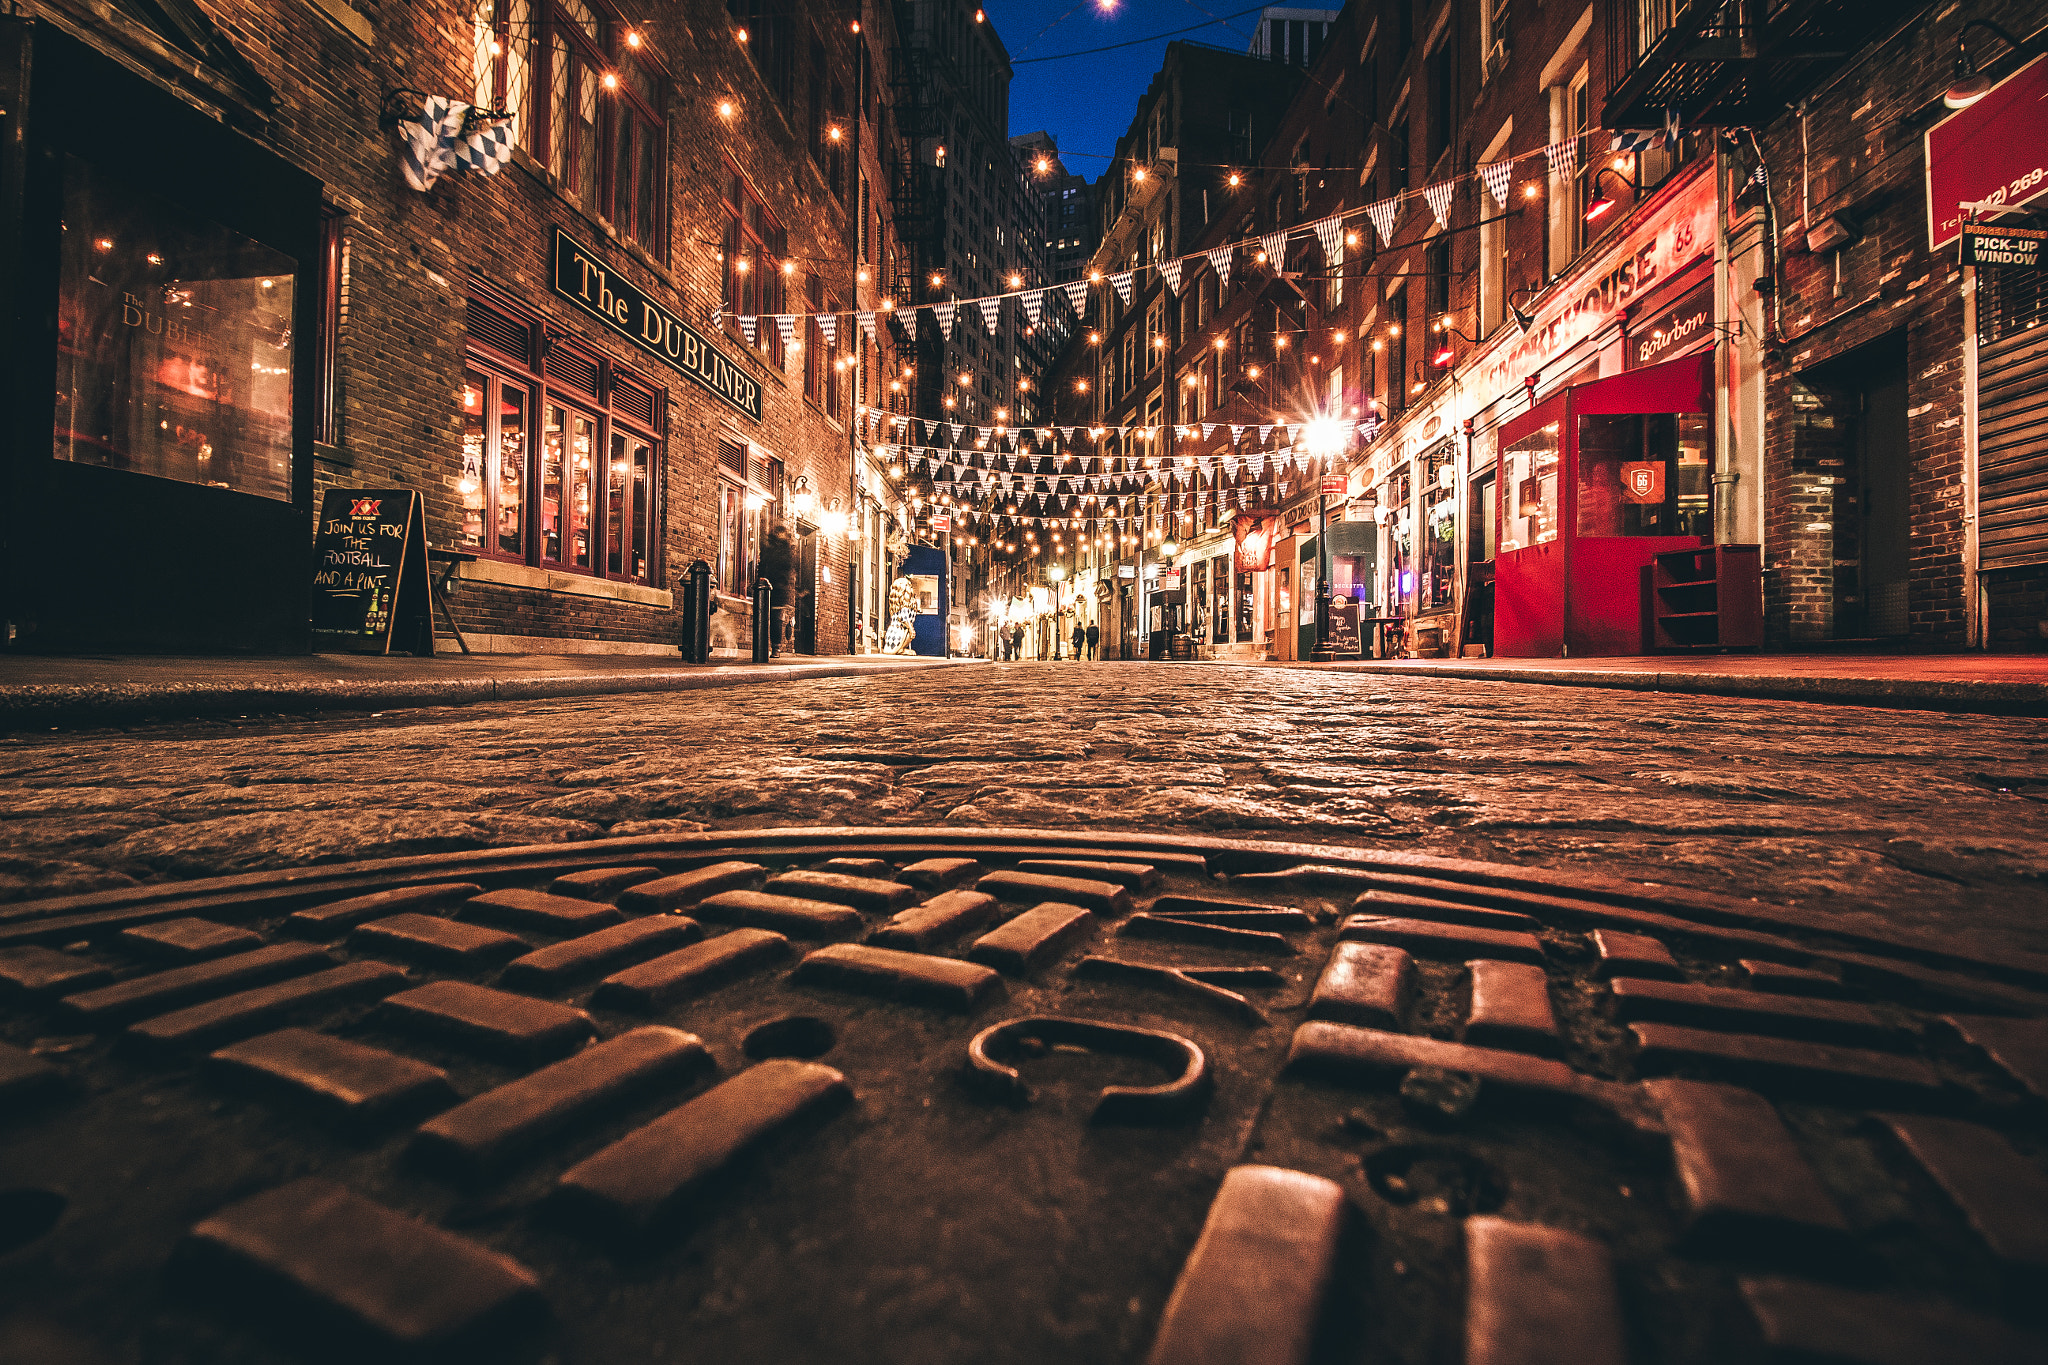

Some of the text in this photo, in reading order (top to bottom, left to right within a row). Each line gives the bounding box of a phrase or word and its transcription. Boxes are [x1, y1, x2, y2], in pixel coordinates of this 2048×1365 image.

[1940, 213, 1967, 231] Tel:
[1964, 225, 2007, 236] BURGER
[1974, 237, 2039, 252] PICK-UP
[1974, 250, 2039, 265] WINDOW
[122, 291, 145, 308] The
[1489, 224, 1693, 392] SMOKEHOUSE 66
[573, 252, 757, 414] The DUBLINER
[1639, 311, 1708, 362] Bourbon
[465, 458, 477, 477] A
[1637, 474, 1648, 487] 66
[348, 499, 383, 515] XX
[324, 519, 403, 540] JOIN US FOR
[342, 535, 373, 550] THE
[1201, 546, 1216, 556] STREET
[323, 550, 391, 567] FOOTBALL
[314, 570, 341, 587] AND
[344, 571, 354, 587] A
